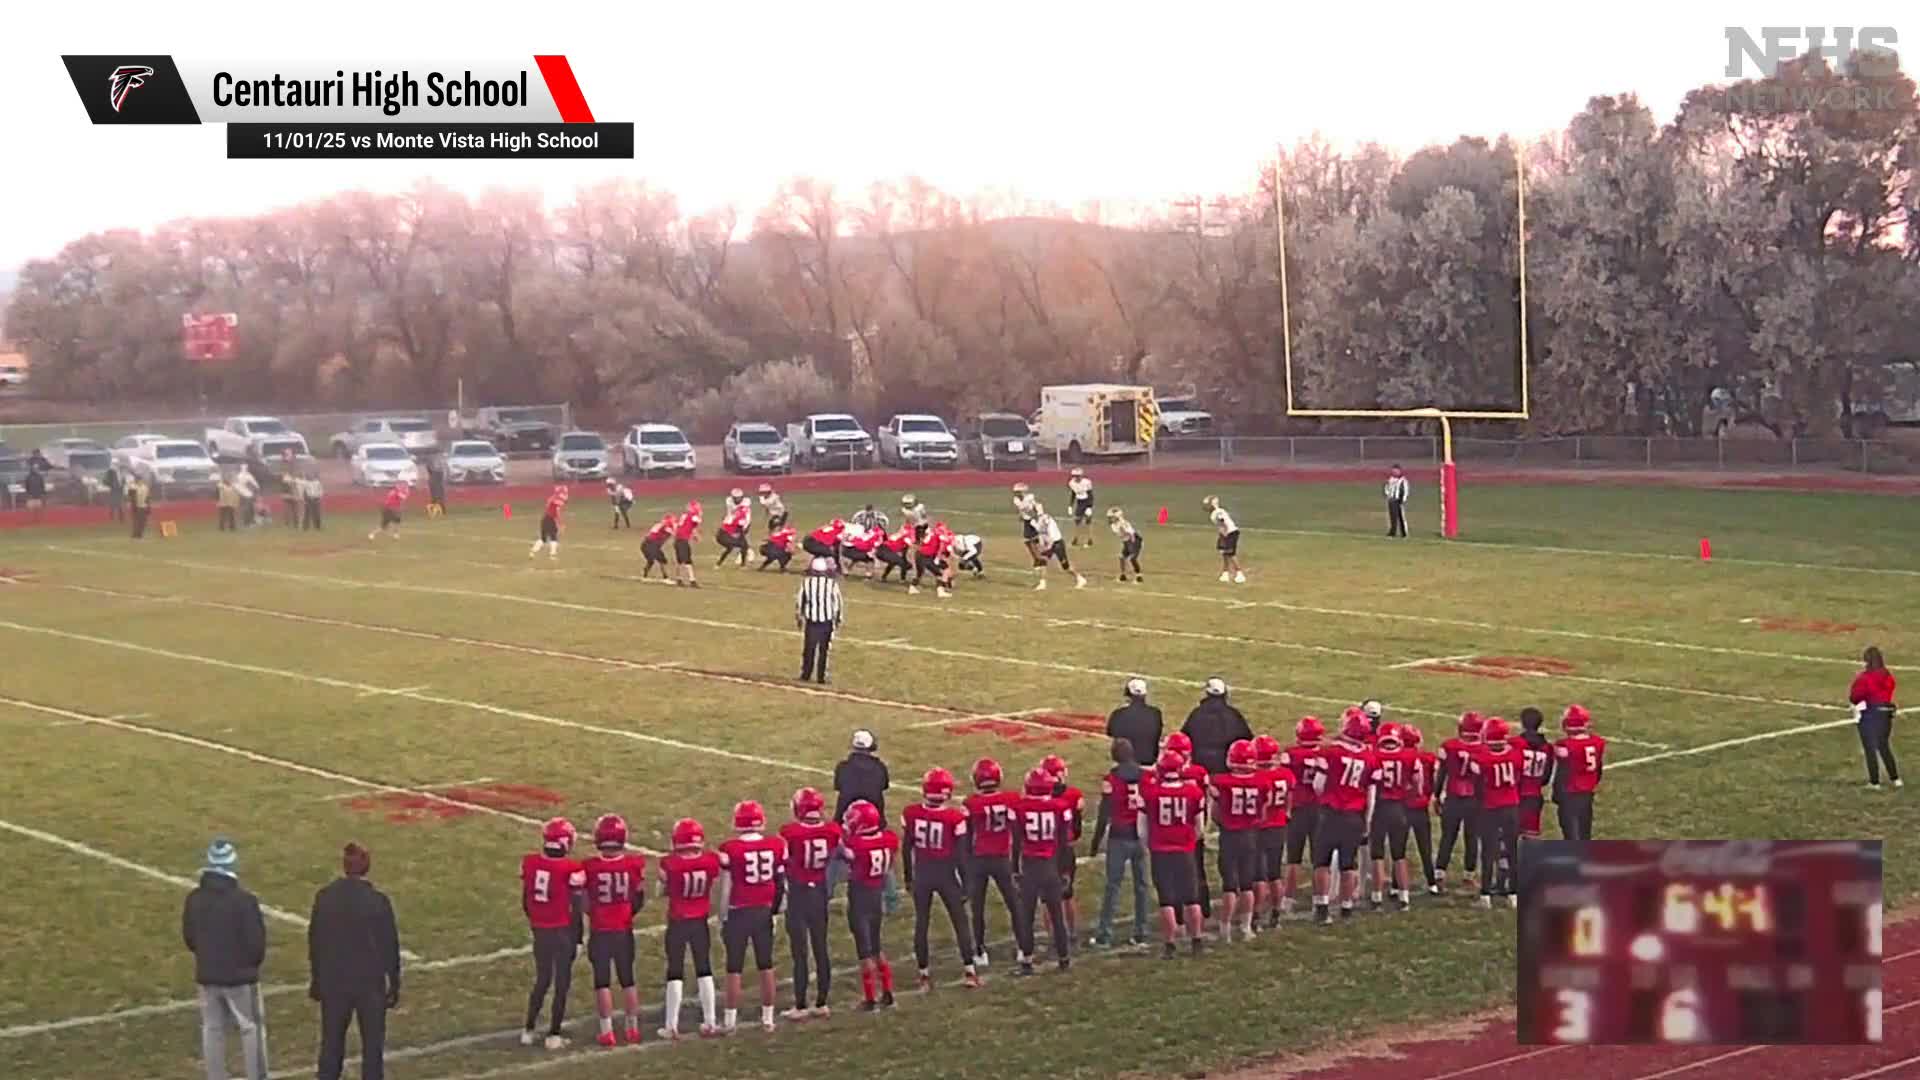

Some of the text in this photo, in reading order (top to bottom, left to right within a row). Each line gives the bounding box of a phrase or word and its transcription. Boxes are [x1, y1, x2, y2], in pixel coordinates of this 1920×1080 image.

[1340, 756, 1366, 788] 78
[1584, 746, 1597, 771] 5
[1381, 760, 1402, 788] 51
[1493, 761, 1515, 788] 14
[1158, 796, 1187, 826] 64
[1231, 787, 1259, 815] 65
[984, 804, 1007, 833] 15
[1025, 811, 1055, 841] 20
[914, 819, 944, 849] 50
[743, 850, 775, 884] 33
[804, 838, 828, 870] 12
[869, 847, 892, 877] 81
[534, 869, 551, 903] 9
[597, 871, 630, 903] 34
[683, 870, 707, 897] 10
[1572, 905, 1605, 957] 0
[1554, 988, 1592, 1042] 3
[1661, 987, 1700, 1042] 6
